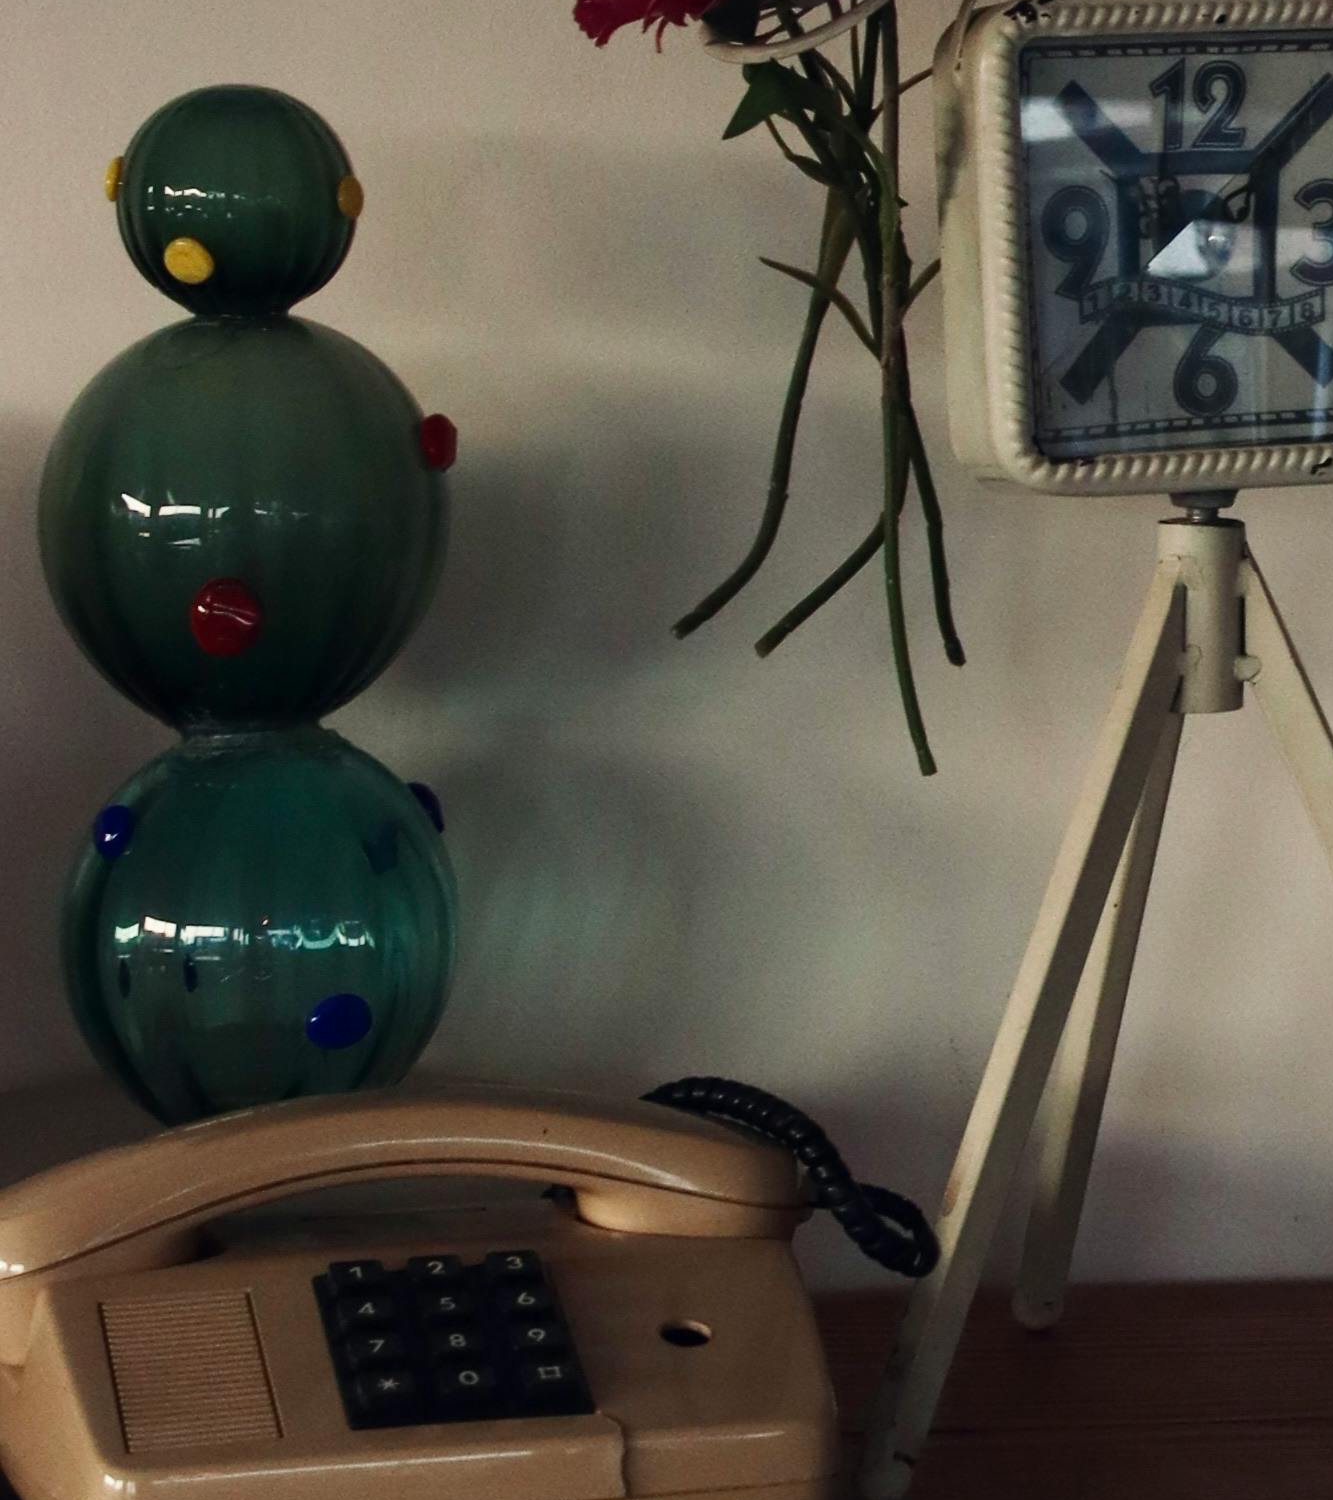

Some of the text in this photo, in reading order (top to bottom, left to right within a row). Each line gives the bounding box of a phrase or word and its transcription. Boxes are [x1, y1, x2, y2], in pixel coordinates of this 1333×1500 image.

[1148, 56, 1247, 151] 12
[1040, 184, 1111, 301] 9
[1206, 300, 1221, 320] 5
[1238, 308, 1253, 327] 6
[1267, 310, 1282, 327] 7
[1300, 301, 1316, 320] 8
[1172, 324, 1239, 418] 6
[349, 1255, 524, 1279] 1 2 3
[357, 1291, 536, 1315] 4 5 6
[368, 1328, 546, 1353] 7 8 9
